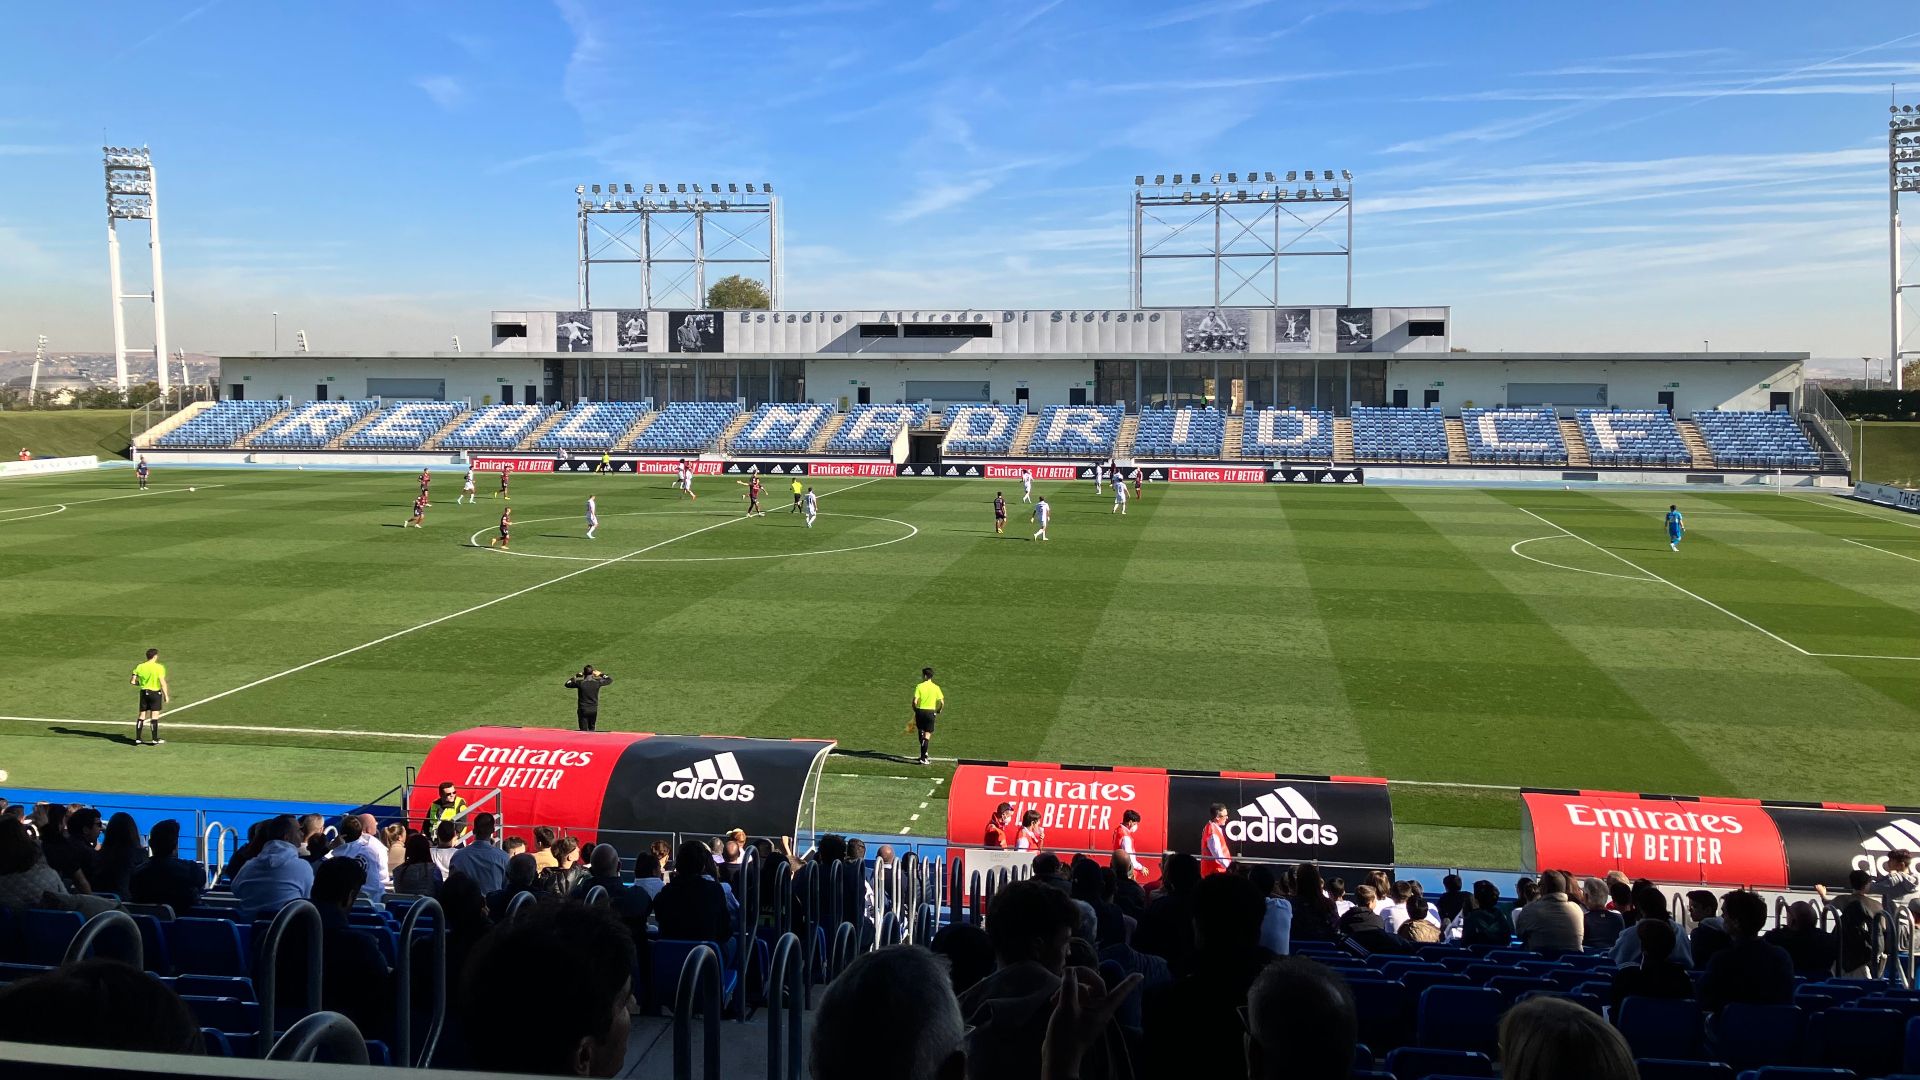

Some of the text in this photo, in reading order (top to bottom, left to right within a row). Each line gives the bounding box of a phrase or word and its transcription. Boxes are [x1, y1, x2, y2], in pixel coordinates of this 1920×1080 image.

[740, 311, 843, 323] Estadio
[879, 311, 984, 323] Alfredo
[1002, 311, 1029, 323] Di
[274, 403, 1655, 452] REAL MADRID CF
[473, 460, 553, 471] Emirates FLY BETTER
[640, 462, 681, 473] Emirate
[698, 463, 722, 473] BETTER
[811, 464, 854, 475] Emirates
[858, 464, 870, 475] FLY
[870, 465, 895, 475] BETTER
[987, 466, 1075, 478] Emirats FLY BETTER
[1171, 469, 1264, 481] Emirates FLY BETTER
[457, 743, 594, 767] Emirates
[465, 765, 565, 790] FLY BETTER
[985, 775, 1136, 801] Emirates
[656, 778, 755, 802] adidas
[1042, 803, 1112, 830] BETTER
[1563, 803, 1743, 834] Emirates
[1225, 816, 1339, 846] adidas
[1601, 832, 1723, 864] FLY BETTER
